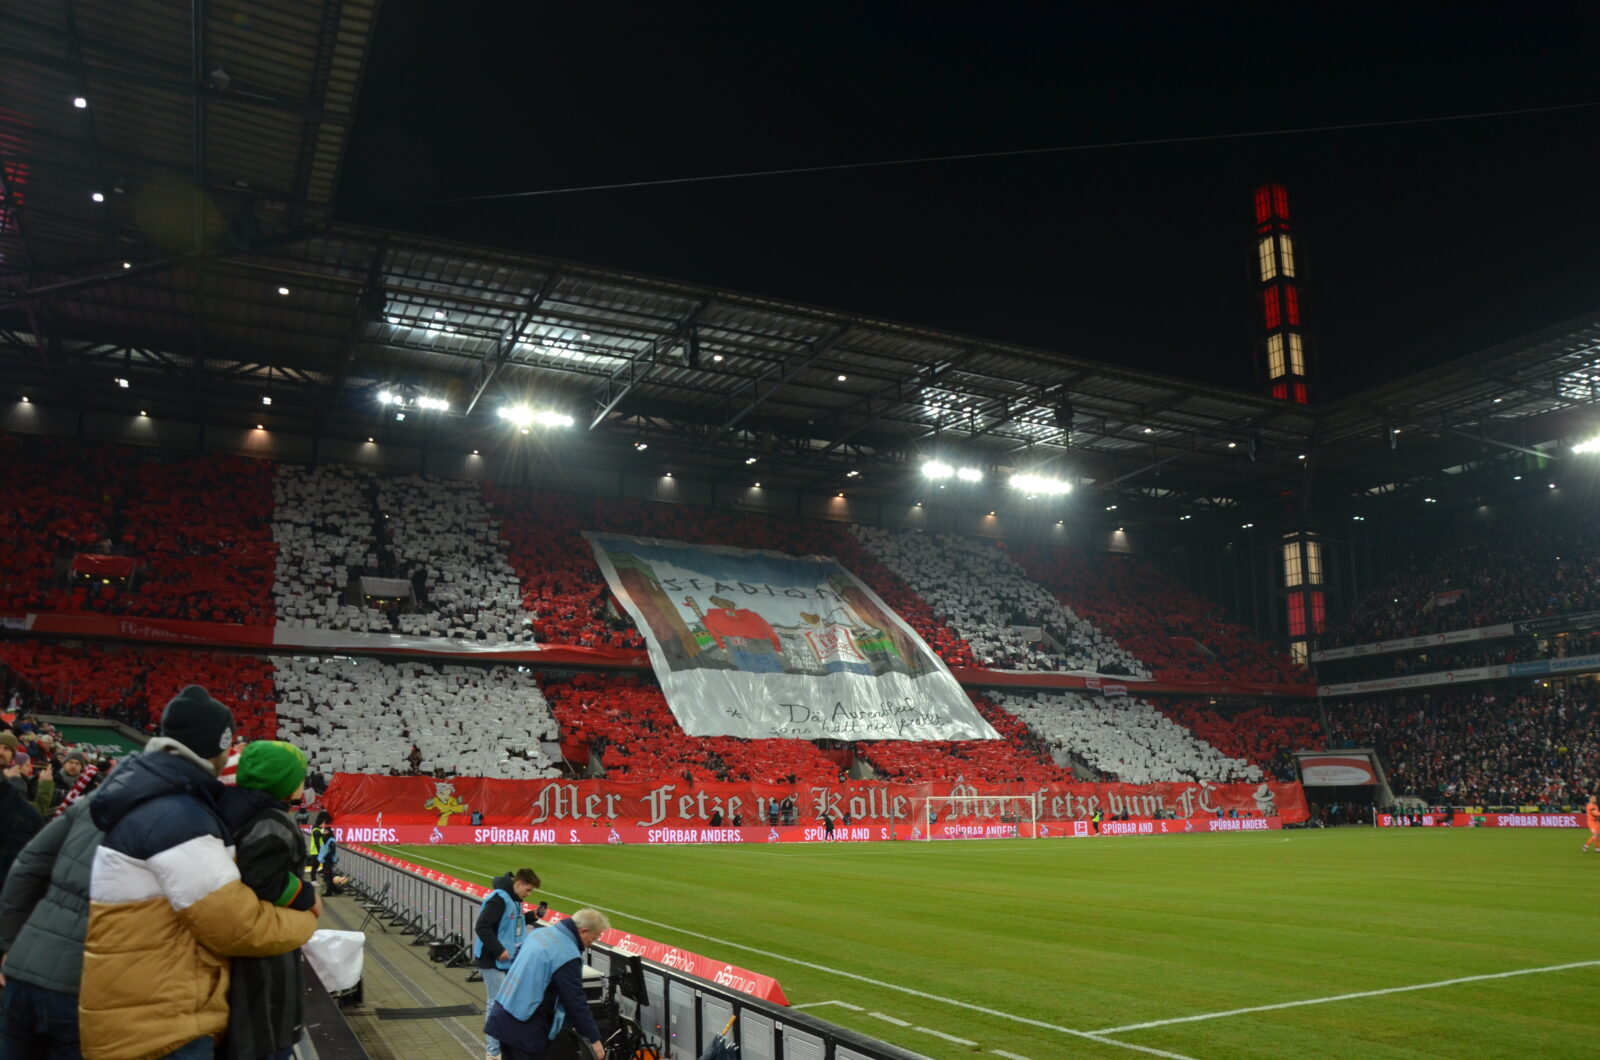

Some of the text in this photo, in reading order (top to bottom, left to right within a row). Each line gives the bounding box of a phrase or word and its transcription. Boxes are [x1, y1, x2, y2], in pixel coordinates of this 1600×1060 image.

[531, 782, 622, 826] Mer
[637, 784, 743, 827] Fetze
[810, 786, 908, 821] Kölle
[945, 784, 1011, 822] Mer
[1176, 783, 1221, 819] FC
[1209, 819, 1269, 831] SPÜRBAR ANDERS.
[1497, 813, 1580, 827] SPÜRBAR ANDERS.
[475, 826, 531, 843] SPÜRBAR
[1102, 821, 1137, 834] SPÜRBAR
[346, 828, 399, 842] ANDERS.
[648, 827, 743, 843] SPÜRBAR ANDERS.
